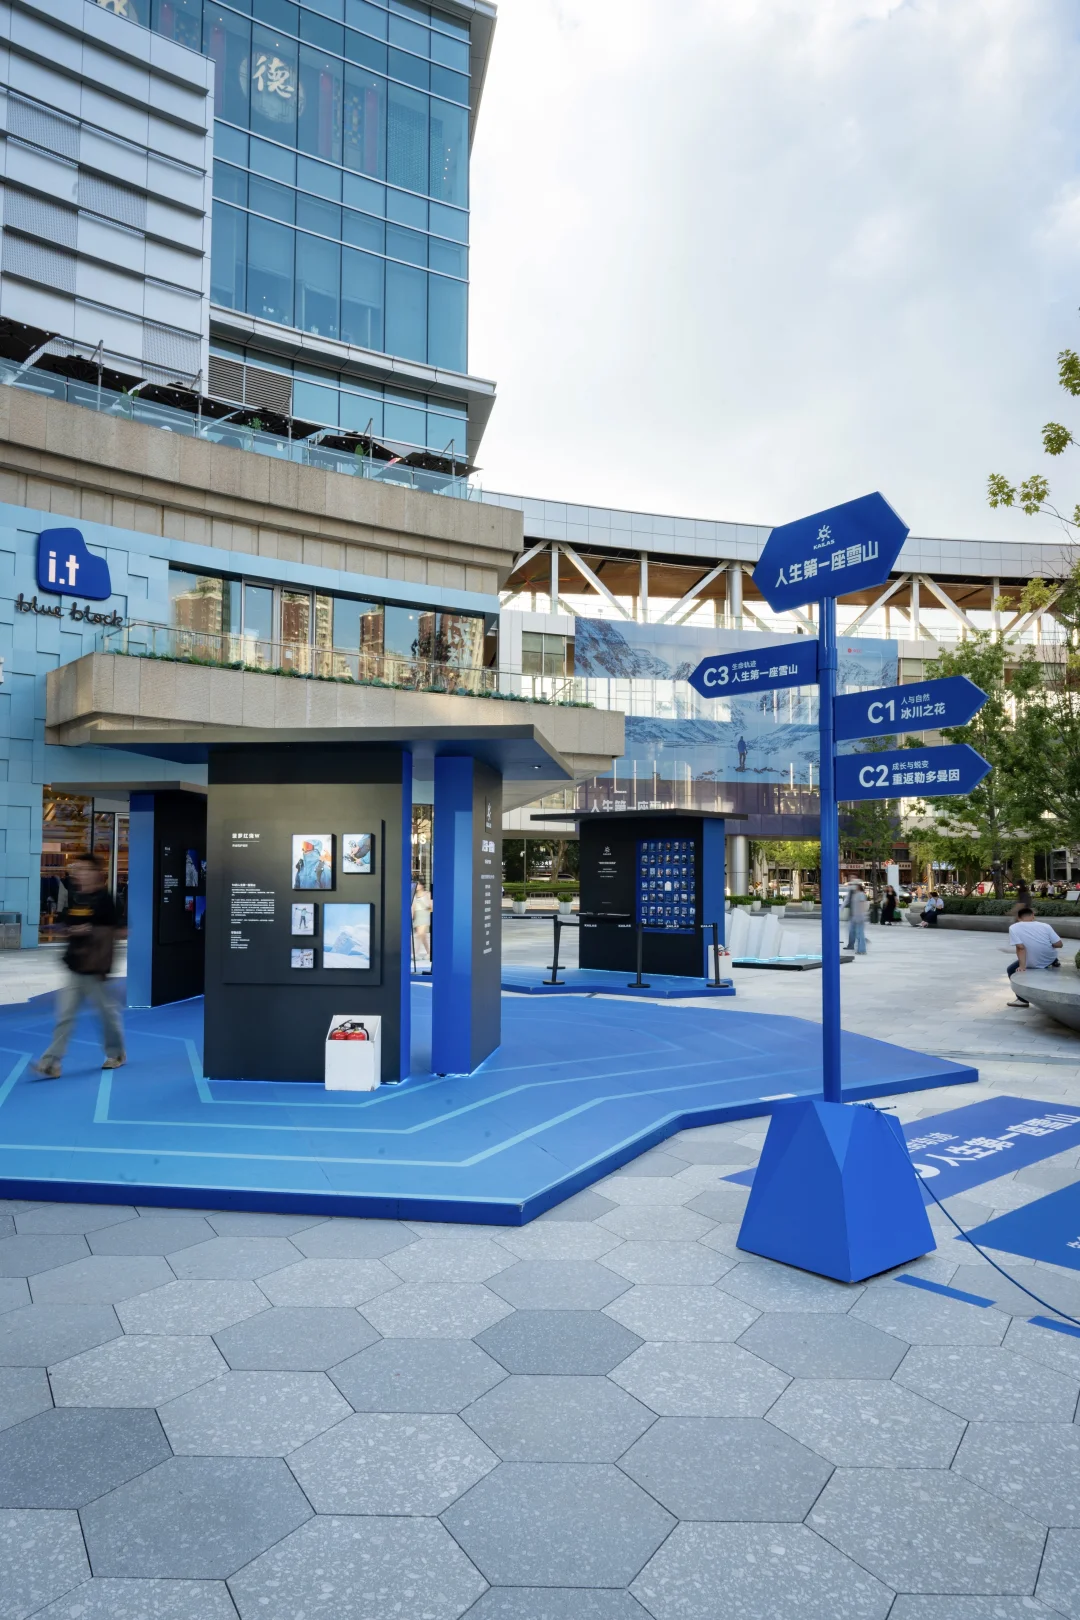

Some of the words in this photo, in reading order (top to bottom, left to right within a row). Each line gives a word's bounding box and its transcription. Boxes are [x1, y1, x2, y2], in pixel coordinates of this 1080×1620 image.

[813, 539, 835, 550] KAILAS
[48, 550, 80, 587] i.t
[775, 540, 879, 588] 人生第一座雪山
[15, 592, 65, 618] blue
[68, 601, 124, 628] block
[703, 665, 730, 687] C3
[731, 660, 757, 671] 生命轨迹
[731, 663, 798, 683] 人生第一座雪山
[900, 693, 931, 706] 人与自然
[867, 699, 895, 724] C1
[900, 702, 946, 720] 冰川之花
[858, 764, 890, 788] C2
[891, 760, 929, 771] 成长与蜕变
[891, 768, 960, 786] 重返勒多曼因
[925, 1113, 1080, 1167] 人生第一座雪山
